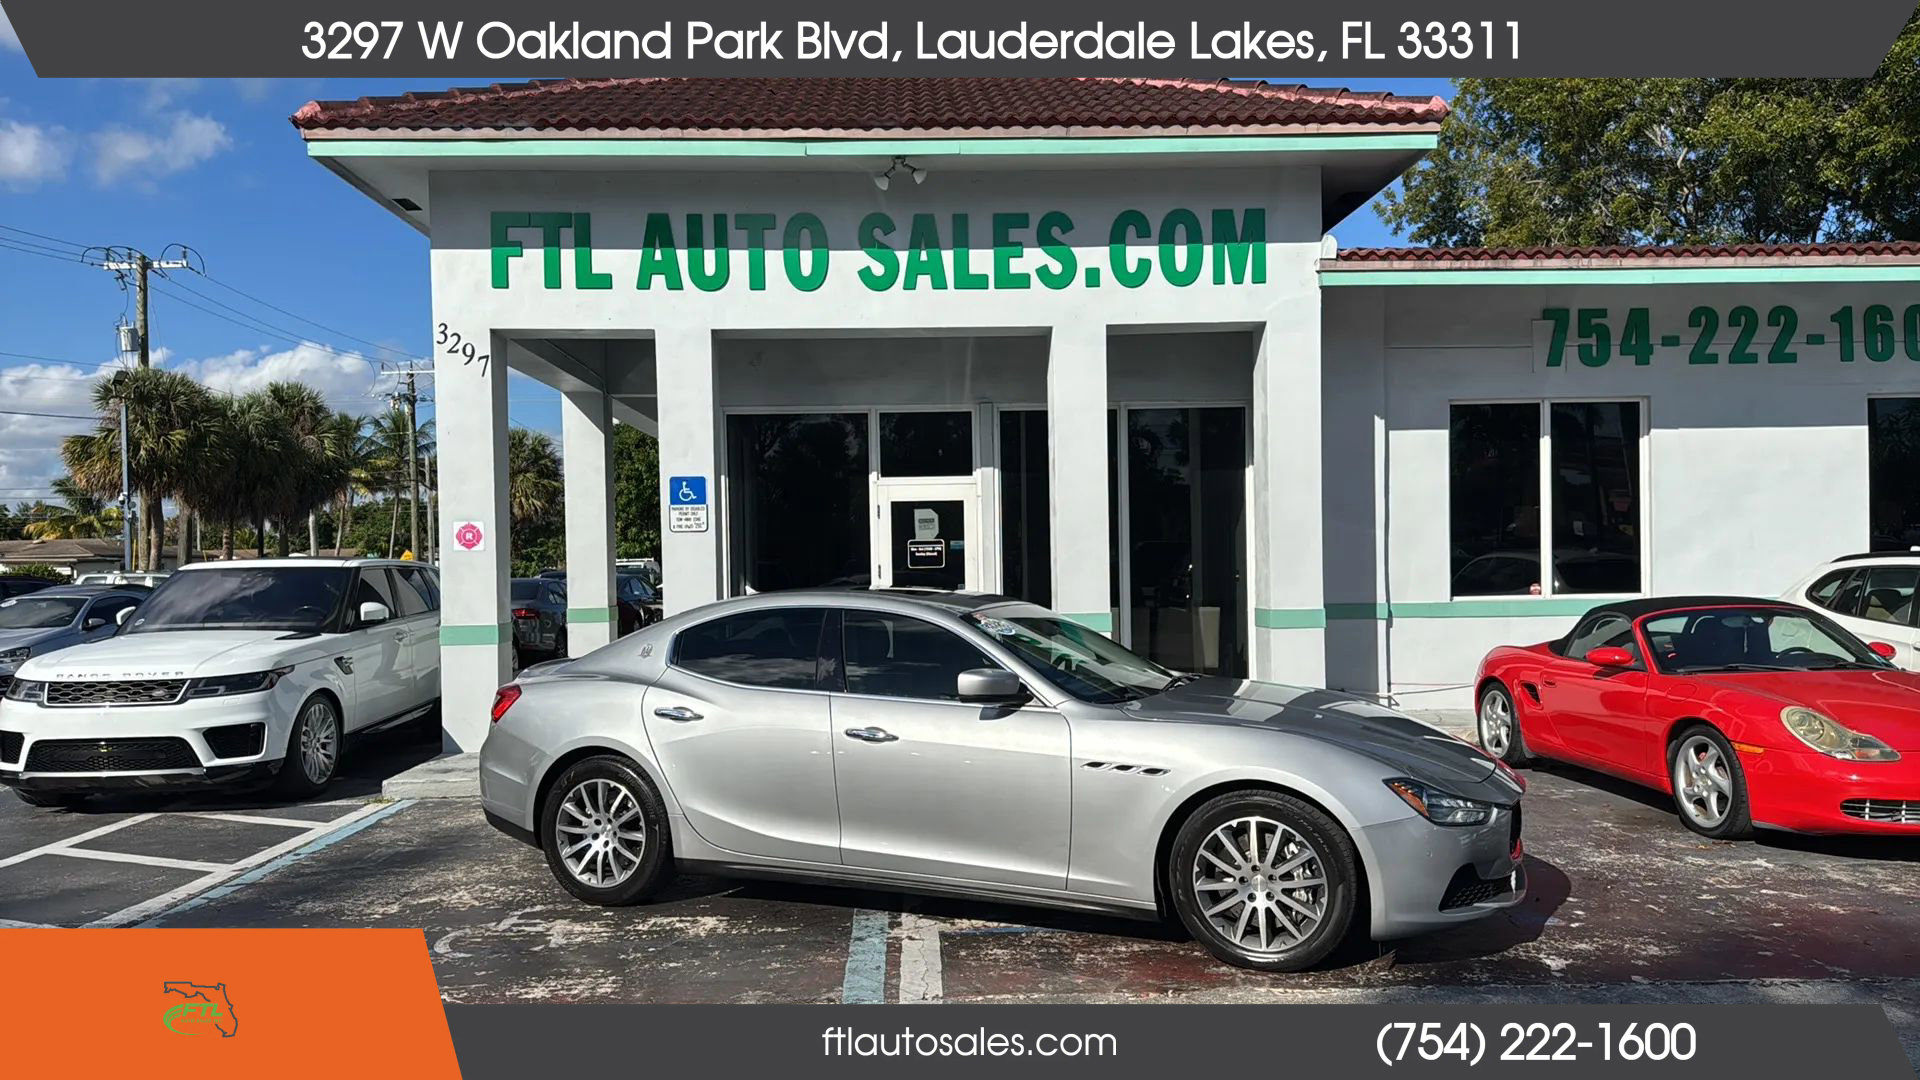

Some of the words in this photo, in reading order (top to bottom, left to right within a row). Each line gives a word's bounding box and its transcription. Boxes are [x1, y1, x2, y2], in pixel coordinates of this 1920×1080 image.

[489, 211, 613, 290] FTL
[635, 211, 831, 292] AUTO
[857, 207, 1268, 293] SALES.COM
[436, 322, 490, 378] 3297
